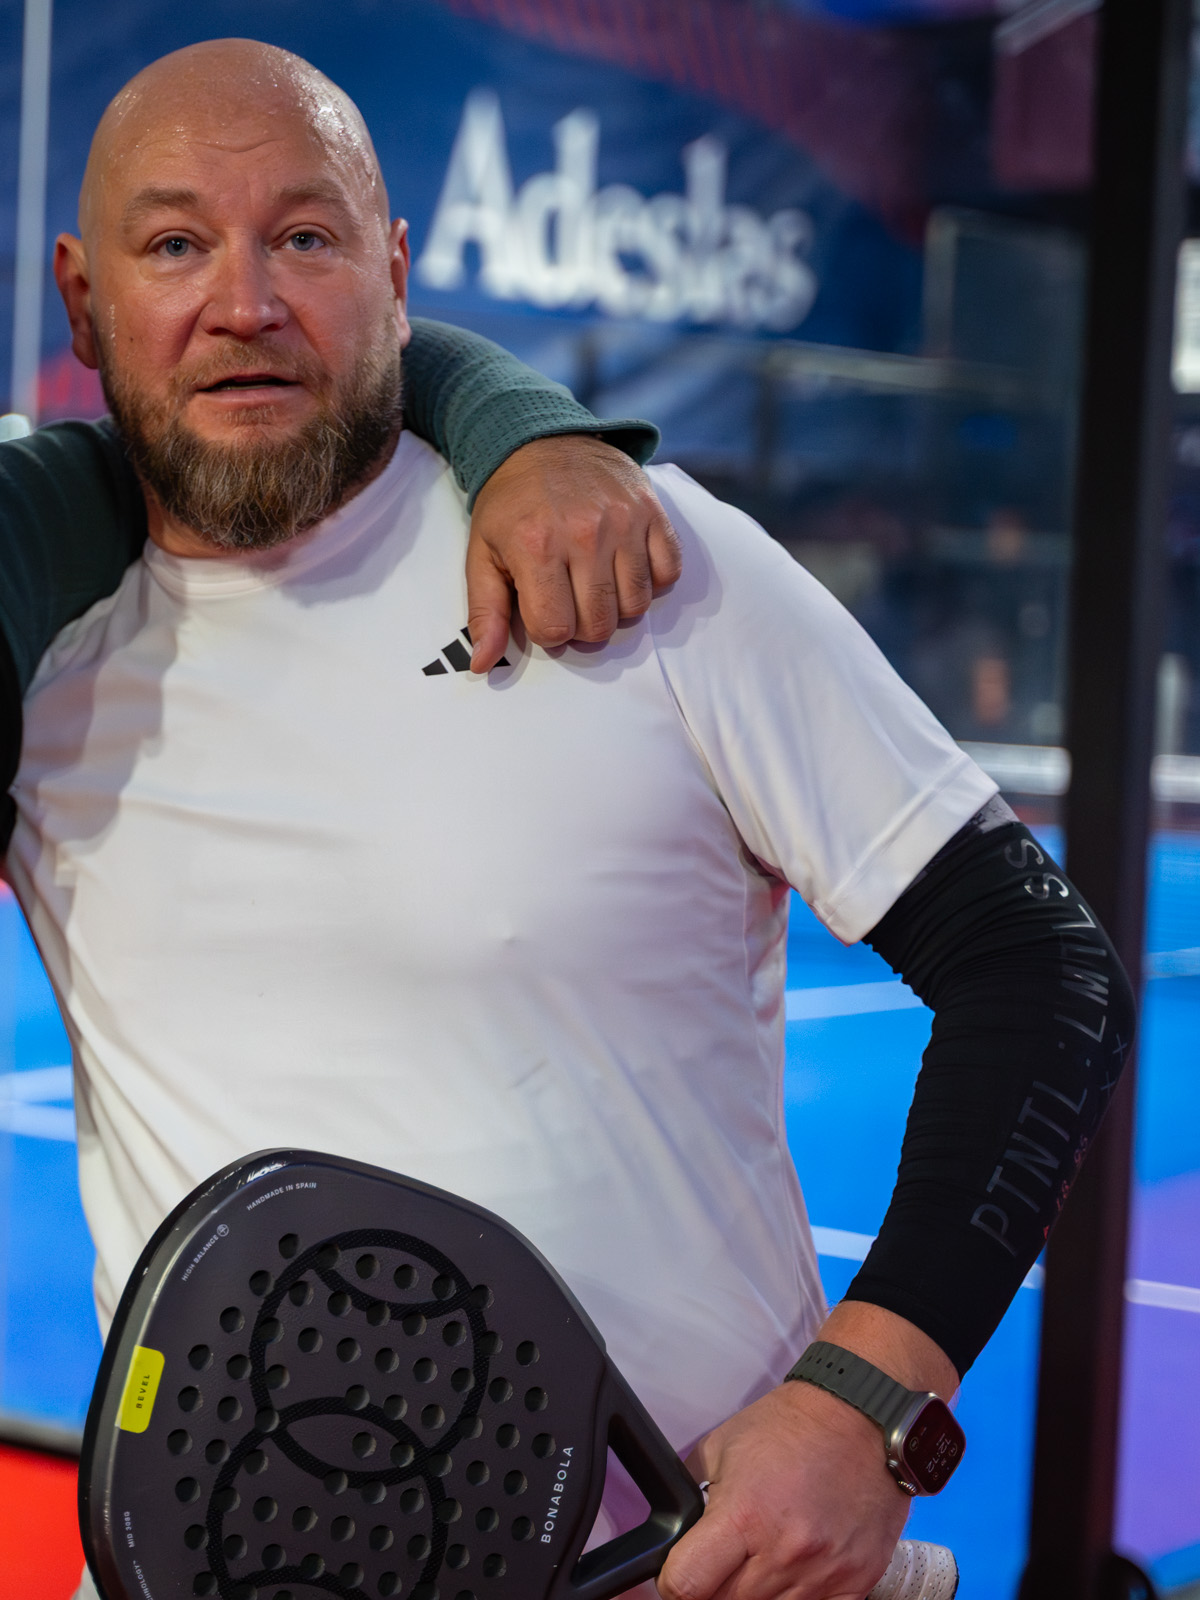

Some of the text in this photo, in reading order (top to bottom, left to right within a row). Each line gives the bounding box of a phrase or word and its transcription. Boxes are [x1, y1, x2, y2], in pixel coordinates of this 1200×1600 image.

[418, 87, 818, 332] Adeslas
[246, 1181, 317, 1212] HANDMADE IN SPAIN
[181, 1234, 219, 1282] HIGH BALANCE
[135, 1374, 151, 1409] BEVEL
[540, 1446, 574, 1544] BONABOLA
[126, 1533, 135, 1548] MID
